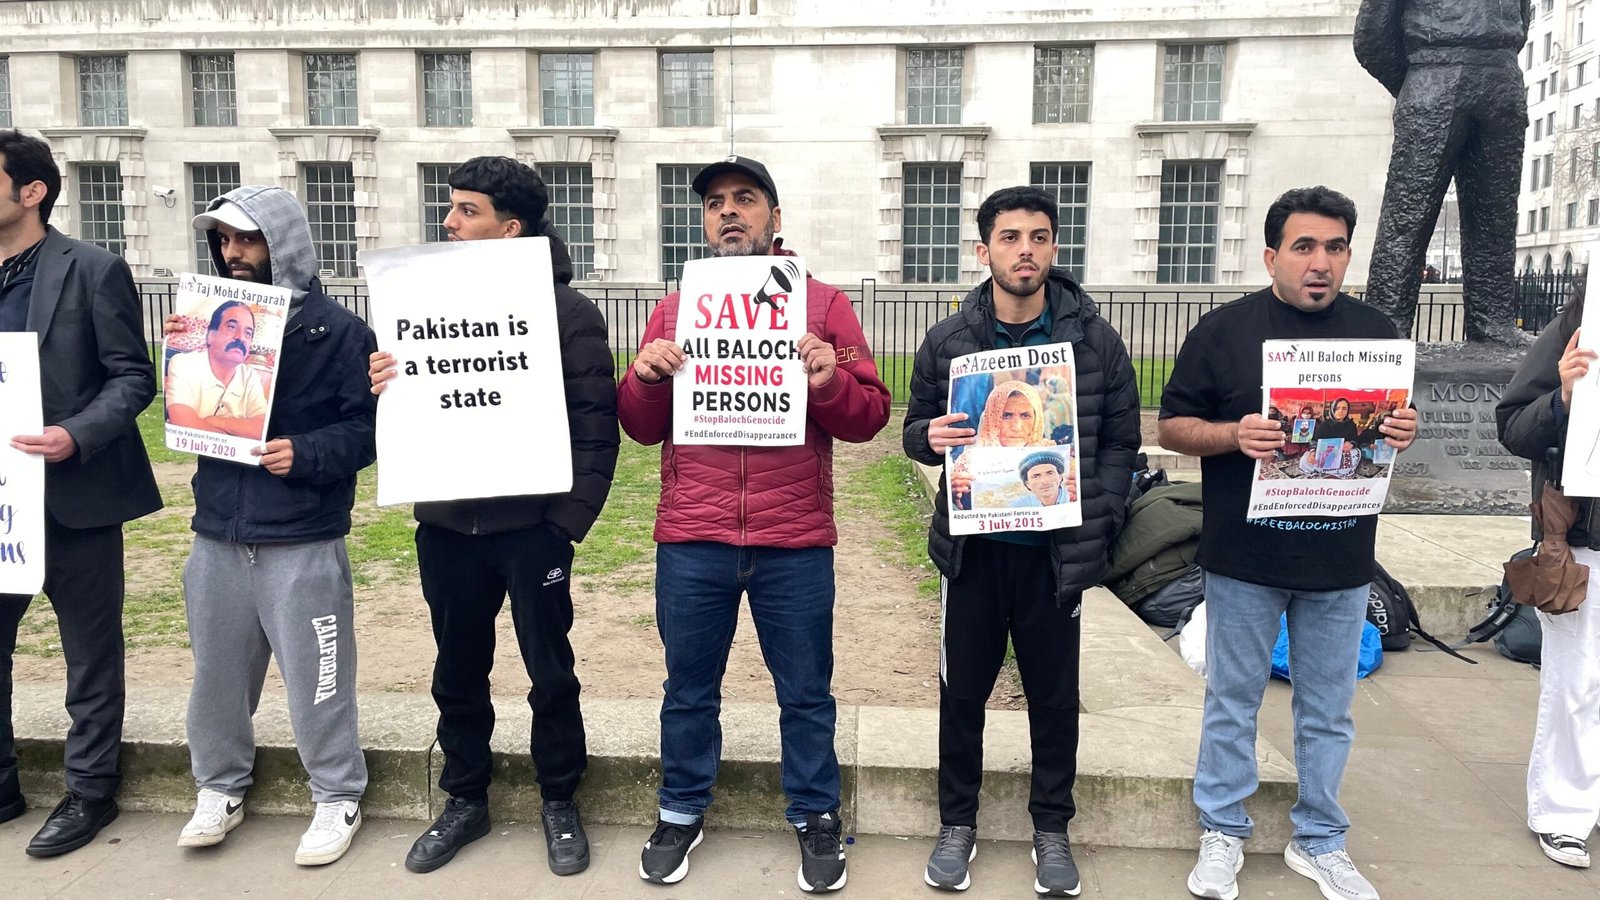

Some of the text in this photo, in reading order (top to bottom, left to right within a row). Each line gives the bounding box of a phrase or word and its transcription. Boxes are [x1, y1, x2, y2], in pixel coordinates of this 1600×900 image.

[197, 283, 211, 297] Taj
[213, 285, 239, 299] Mohd
[241, 290, 286, 306] Sarparah
[694, 293, 789, 330] SAVE
[397, 314, 529, 341] Pakistan is
[682, 338, 801, 360] All BALOCH
[1268, 351, 1402, 366] SAVE All Baloch Missing
[405, 350, 529, 376] a terrorist
[970, 353, 1022, 373] Azeem
[1028, 347, 1068, 366] Dost
[695, 365, 783, 386] MISSING
[1298, 373, 1343, 385] persons
[440, 388, 502, 409] state
[692, 391, 791, 412] PERSONS
[1429, 383, 1510, 402] MON
[694, 415, 786, 426] #StopBalochGenocide
[1422, 412, 1497, 423] FIELD M
[684, 430, 797, 441] #EndEnforcedDisappearances
[1416, 428, 1470, 439] OUNT
[176, 437, 236, 457] 19 July 2020
[1477, 445, 1511, 456] ALA
[1265, 487, 1371, 498] #StopBalochGenocide
[953, 512, 979, 520] Abducted
[980, 512, 987, 520] by
[988, 510, 1013, 518] Pakistani
[1013, 509, 1032, 517] Forces
[1253, 502, 1381, 512] #EndEnforcedDisappearances
[978, 518, 1044, 532] 3 July 2015
[1367, 589, 1389, 635] adida
[311, 614, 338, 705] CALIFORNIA
